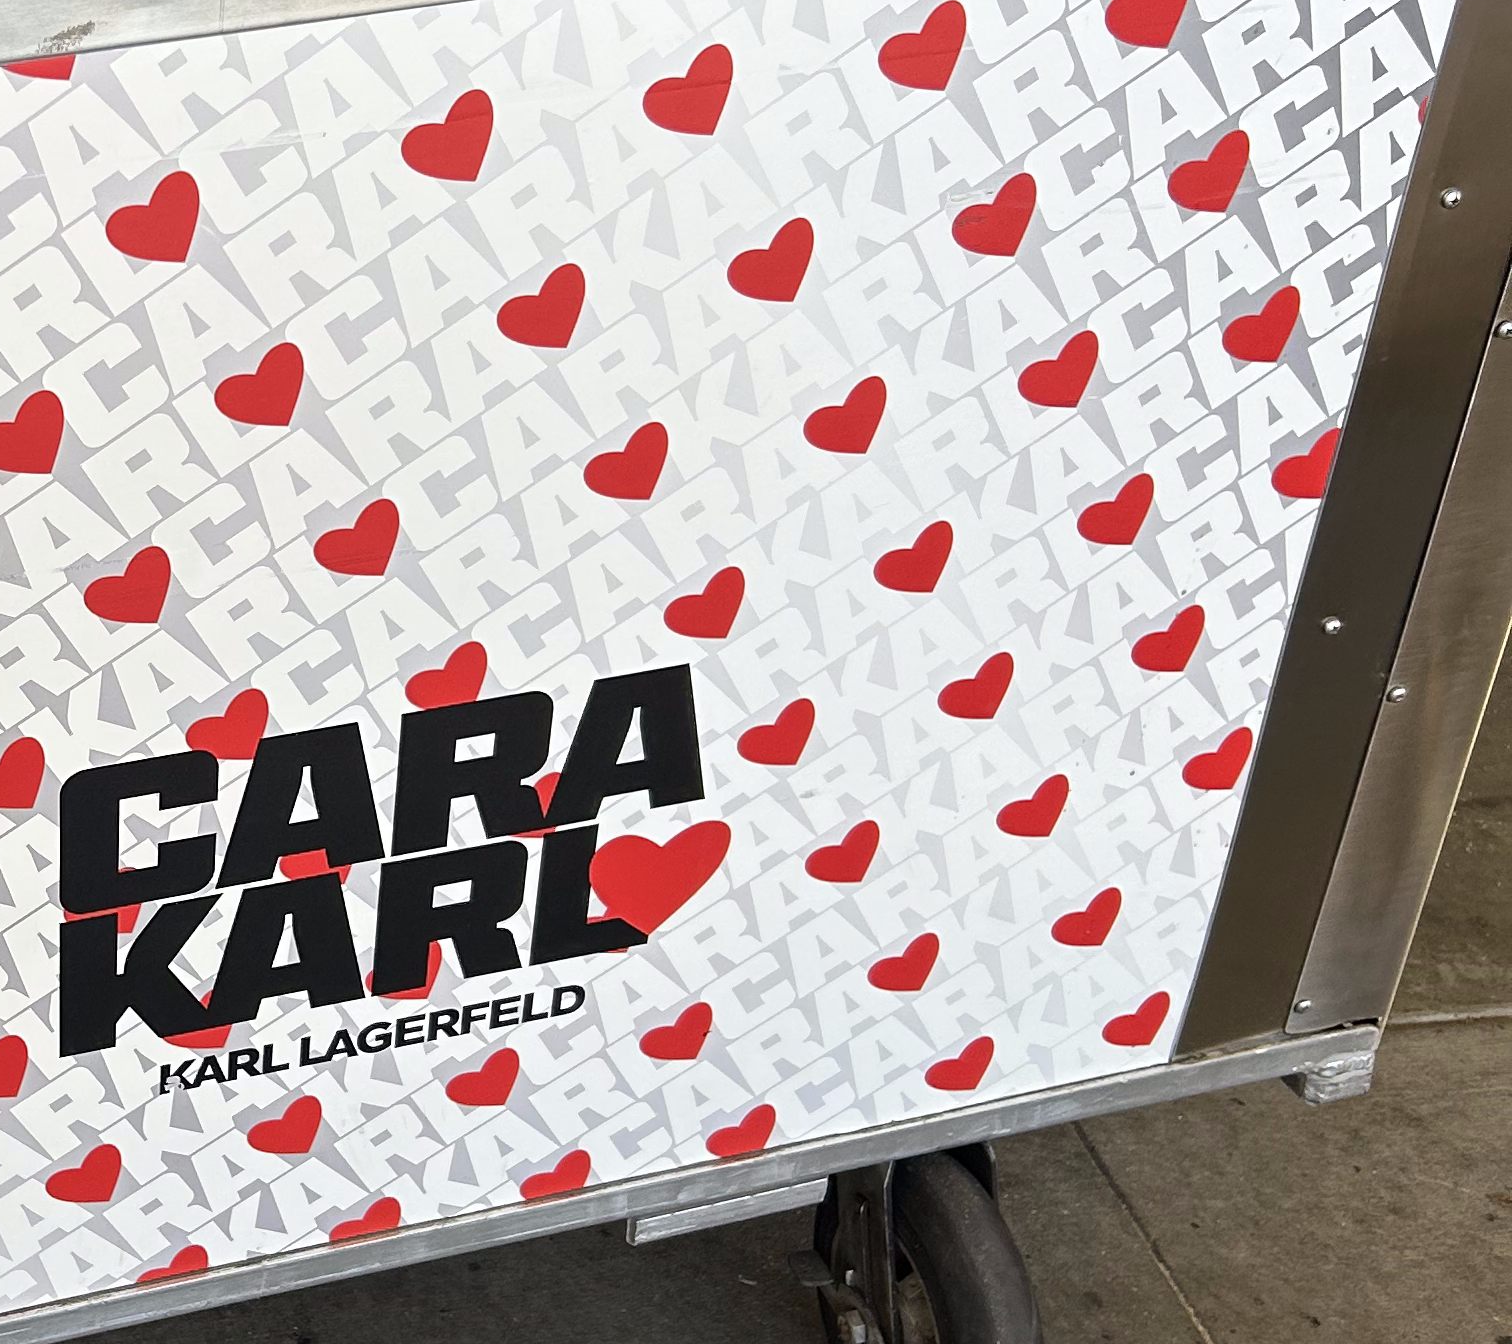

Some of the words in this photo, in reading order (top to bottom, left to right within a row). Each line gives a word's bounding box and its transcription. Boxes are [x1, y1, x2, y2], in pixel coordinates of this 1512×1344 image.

[19, 534, 387, 785] KARL
[384, 257, 775, 548] CARA
[795, 2, 1170, 286] KARL
[42, 133, 459, 445] CARA
[152, 302, 550, 595] CARA
[564, 44, 947, 331] KARL
[287, 88, 696, 398] CARA
[252, 457, 633, 733] CARA
[648, 213, 1014, 482] KARL
[473, 412, 848, 686] CARA
[868, 170, 1227, 437] KARL
[726, 367, 1076, 621] KARL
[935, 324, 1280, 576] KARL
[797, 509, 1133, 749] KARL
[997, 466, 1325, 704] KARL
[59, 663, 705, 914] CARA
[59, 824, 649, 1057] KARL
[385, 1034, 698, 1229] KARL
[701, 807, 1033, 1039] CARA
[1055, 623, 1290, 823] KAR
[507, 852, 845, 1086] CARA
[863, 641, 1186, 868] KARL
[159, 1043, 290, 1095] KARL
[299, 985, 586, 1067] LAGERFELD
[580, 964, 905, 1186] CARA
[923, 762, 1235, 978] KARL
[766, 919, 1086, 1141] CARA
[1108, 799, 1242, 934] KA
[980, 878, 1222, 1080] KAR
